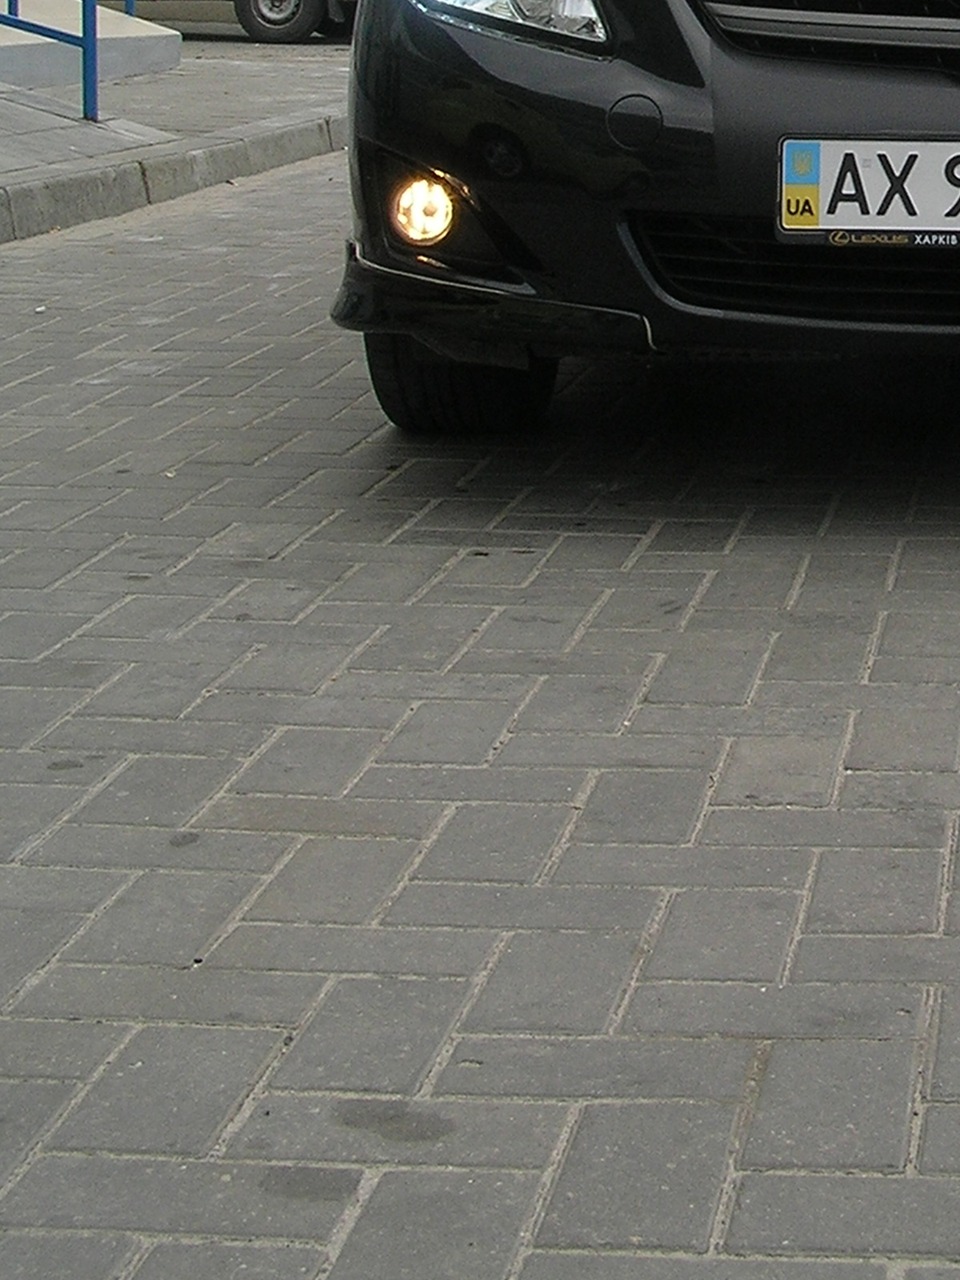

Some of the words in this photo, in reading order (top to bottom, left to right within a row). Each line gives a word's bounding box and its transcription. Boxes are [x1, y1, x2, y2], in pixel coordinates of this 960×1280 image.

[826, 152, 919, 216] AX
[786, 198, 814, 217] UA
[851, 234, 909, 243] LEXUS
[914, 234, 958, 245] ХАРКІВ
